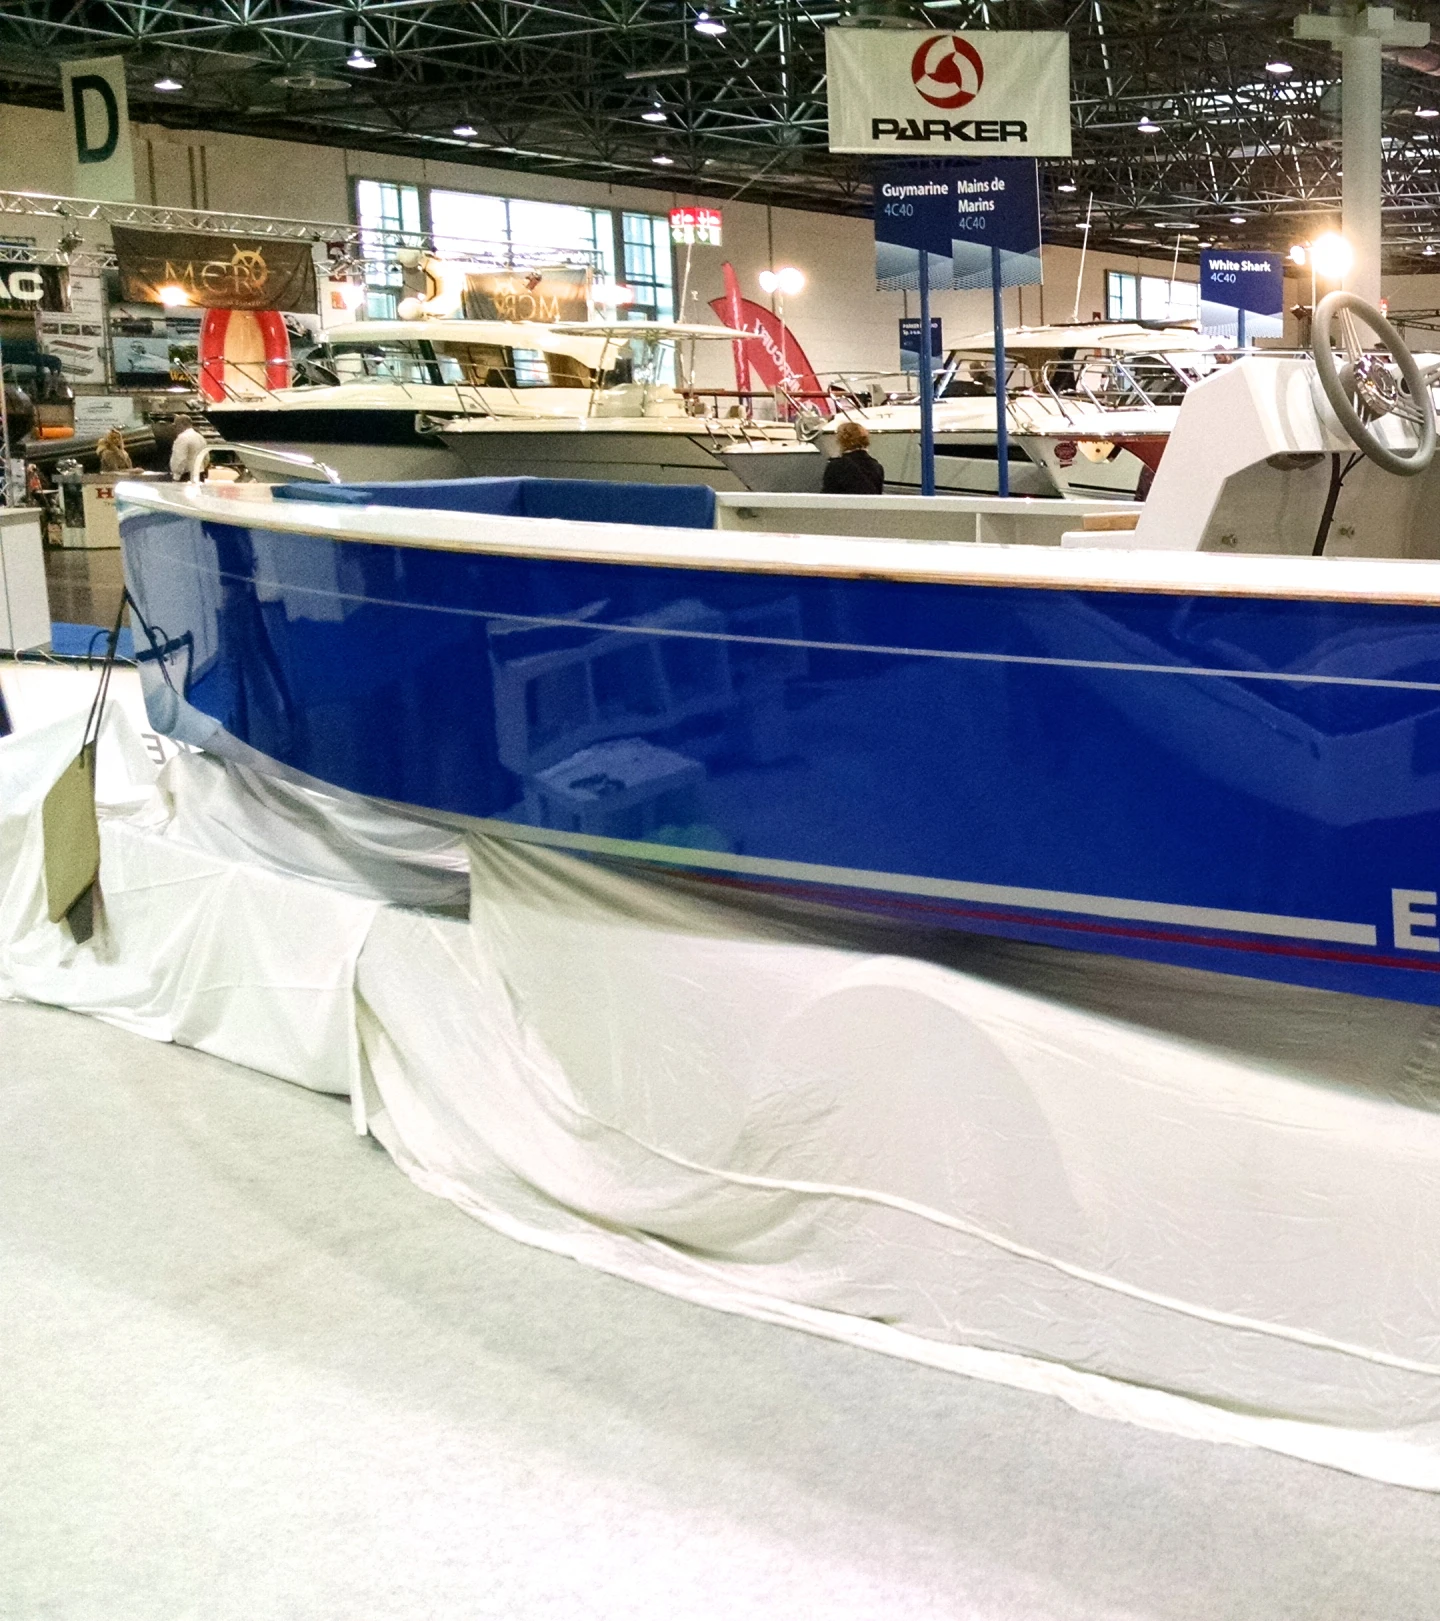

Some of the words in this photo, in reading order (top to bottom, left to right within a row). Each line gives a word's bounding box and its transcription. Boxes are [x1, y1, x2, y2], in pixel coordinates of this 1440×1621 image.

[71, 75, 119, 164] D
[872, 118, 1028, 142] PARKER
[882, 181, 949, 200] Guymarine
[957, 178, 990, 195] Mains
[990, 176, 1006, 191] de
[884, 203, 914, 217] 4C40
[958, 197, 995, 213] Marins
[959, 216, 986, 230] 4C40
[1208, 259, 1240, 271] White
[1241, 260, 1271, 272] Shark
[1210, 272, 1237, 283] 4C40
